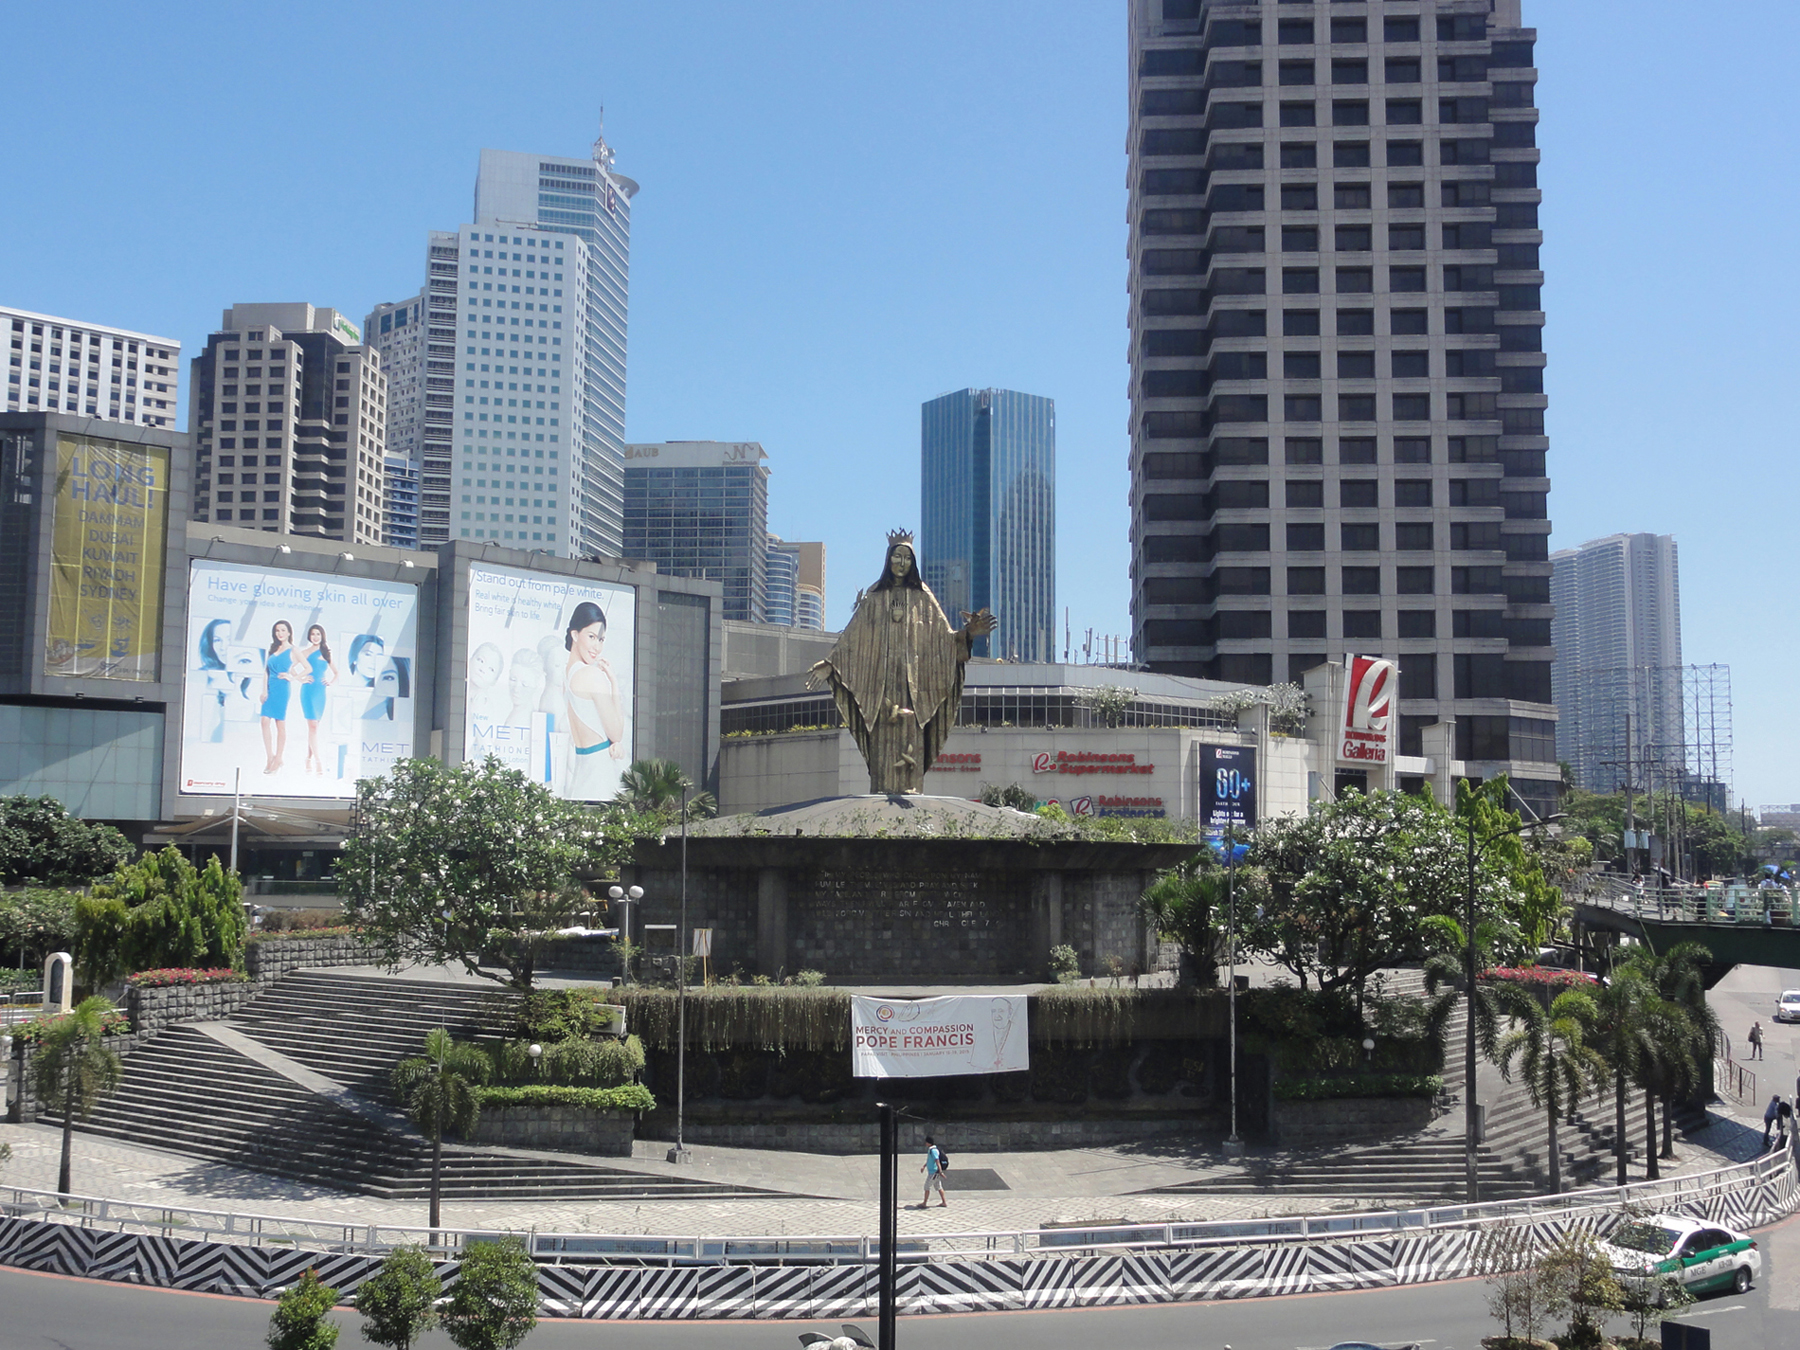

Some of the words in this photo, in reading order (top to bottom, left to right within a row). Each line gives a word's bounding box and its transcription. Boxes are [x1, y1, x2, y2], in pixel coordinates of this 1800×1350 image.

[72, 457, 155, 487] LONG
[71, 479, 154, 509] HAUL!
[78, 509, 145, 529] DAMMAM
[88, 529, 135, 546] DUBAI
[82, 546, 139, 565] KUWAIT
[82, 565, 136, 583] RIYADH
[80, 583, 138, 601] SYDNEY
[207, 576, 248, 593] Have
[253, 582, 312, 602] glowing
[317, 589, 346, 603] skin
[351, 592, 368, 605] all
[372, 597, 403, 609] over
[476, 569, 507, 586] Stand
[508, 578, 527, 589] out
[527, 577, 552, 593] from
[553, 583, 575, 597] pale
[577, 586, 605, 600] white.
[207, 594, 237, 604] Change
[475, 589, 491, 600] Real
[491, 592, 510, 604] white
[517, 596, 542, 610] healthy
[475, 602, 494, 617] Bring
[494, 605, 506, 616] fair
[521, 611, 529, 619] to
[473, 713, 489, 721] New
[473, 723, 530, 741] MET
[361, 741, 410, 754] MET
[473, 743, 530, 755] TATHIONE
[1343, 740, 1386, 761] Galleria
[361, 756, 397, 764] TATHIO
[936, 753, 982, 764] insons
[1057, 750, 1135, 763] Robinsons
[1058, 762, 1155, 776] Supermarket
[1098, 794, 1162, 807] Robinsons
[855, 1026, 889, 1035] MERCY
[909, 1024, 974, 1035] COMPASSION
[856, 1035, 898, 1048] POPE
[904, 1033, 974, 1048] FRANCIS
[1690, 1265, 1707, 1278] MGE
